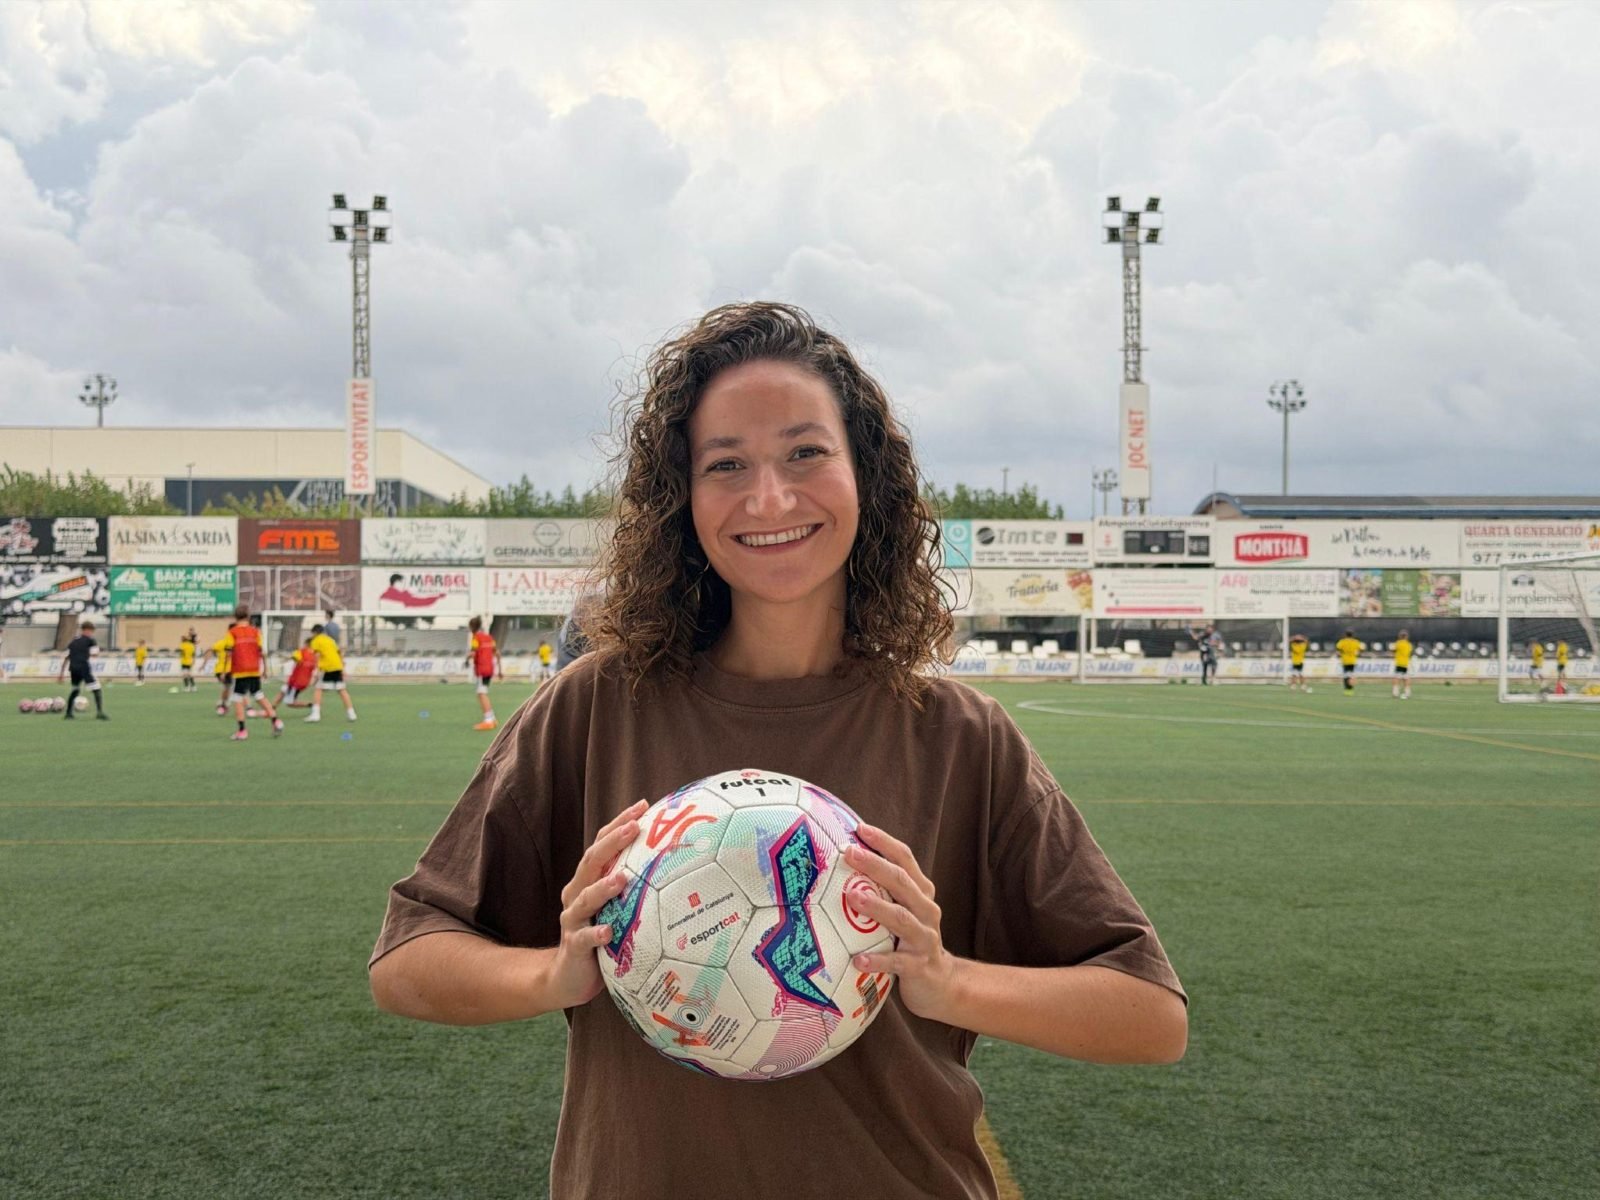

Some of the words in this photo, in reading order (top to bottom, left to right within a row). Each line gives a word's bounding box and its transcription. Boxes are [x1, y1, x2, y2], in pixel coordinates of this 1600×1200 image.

[1128, 409, 1144, 438] NET
[352, 382, 369, 490] ESPORTIVITAT
[1128, 442, 1147, 470] JOC
[115, 529, 168, 545] ALSINA
[1464, 526, 1511, 537] QUARTA
[493, 546, 555, 557] GERMANS
[1472, 552, 1501, 565] 977
[409, 574, 469, 587] MARBEL
[1007, 580, 1059, 599] Trattoria
[146, 662, 172, 672] APEI
[396, 661, 433, 672] MAPEI
[1034, 660, 1072, 672] MAPEI
[1097, 660, 1134, 672] MAPEI
[1418, 663, 1456, 673] MAPEI
[720, 778, 793, 791] futcat
[756, 787, 767, 797] 1
[667, 912, 696, 930] Generalitat
[697, 907, 704, 915] de
[705, 892, 734, 910] Catalunya
[690, 911, 741, 945] esportcat
